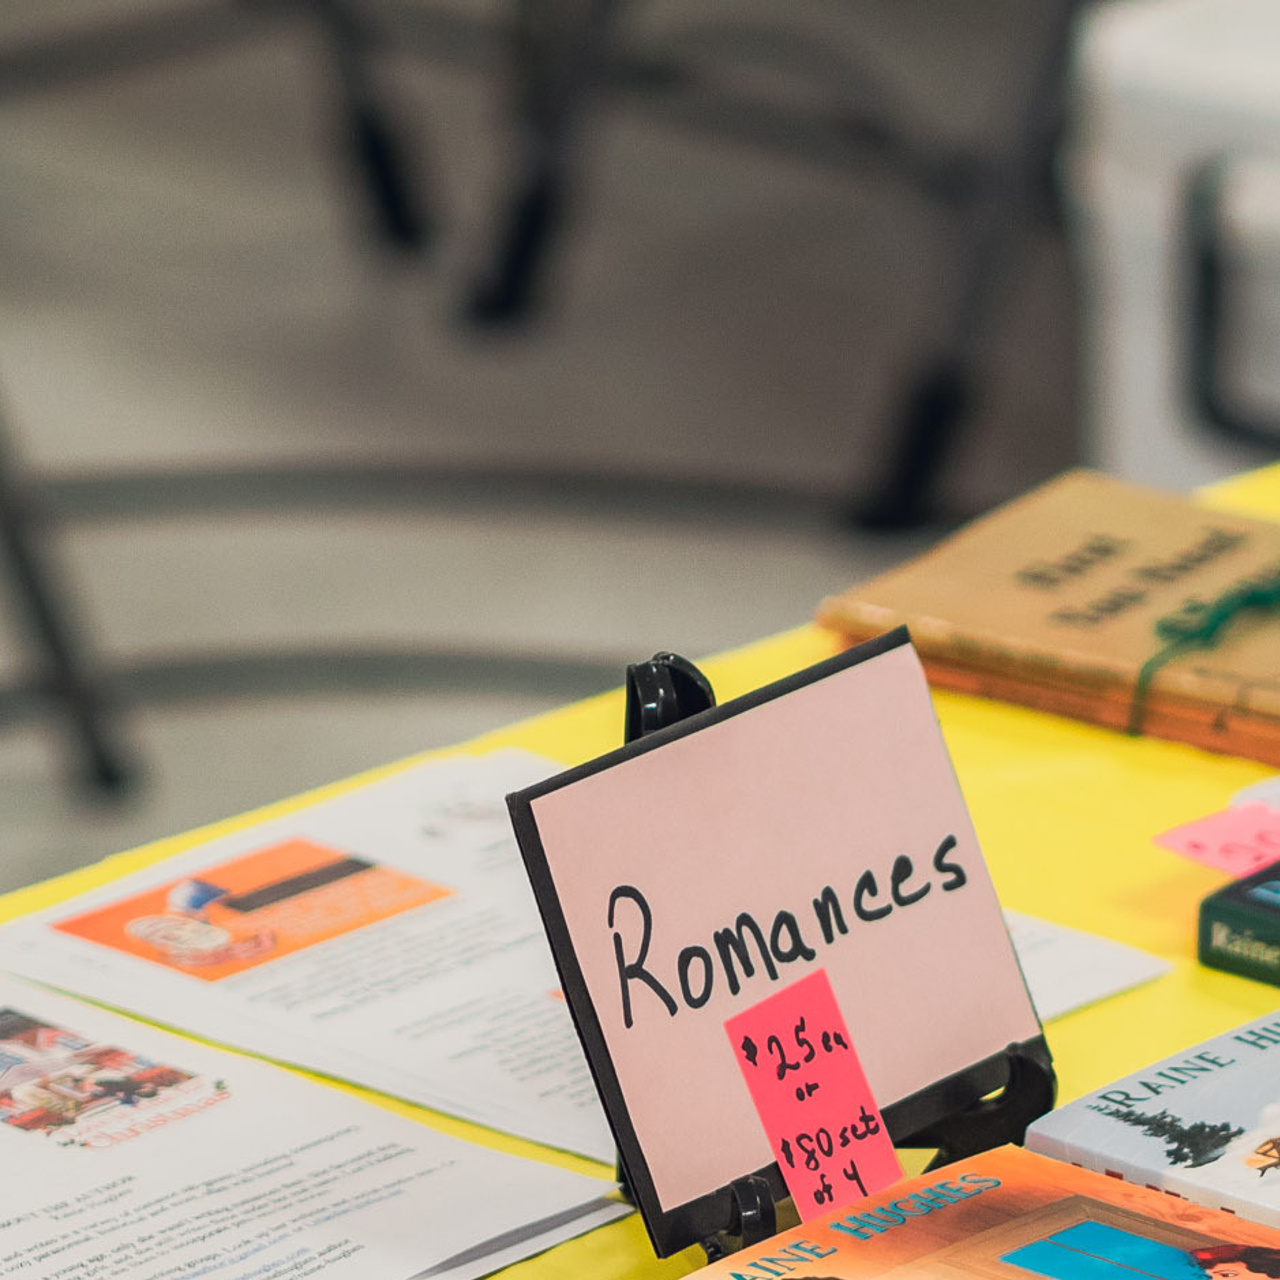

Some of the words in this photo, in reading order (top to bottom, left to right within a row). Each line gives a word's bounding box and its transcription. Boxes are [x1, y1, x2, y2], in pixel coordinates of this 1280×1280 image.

[608, 835, 967, 1029] Romances
[1099, 1050, 1237, 1110] RAINE
[840, 1105, 880, 1148] set
[814, 1173, 834, 1206] of
[843, 1159, 869, 1198] 4
[829, 1172, 1002, 1242] HUGHES
